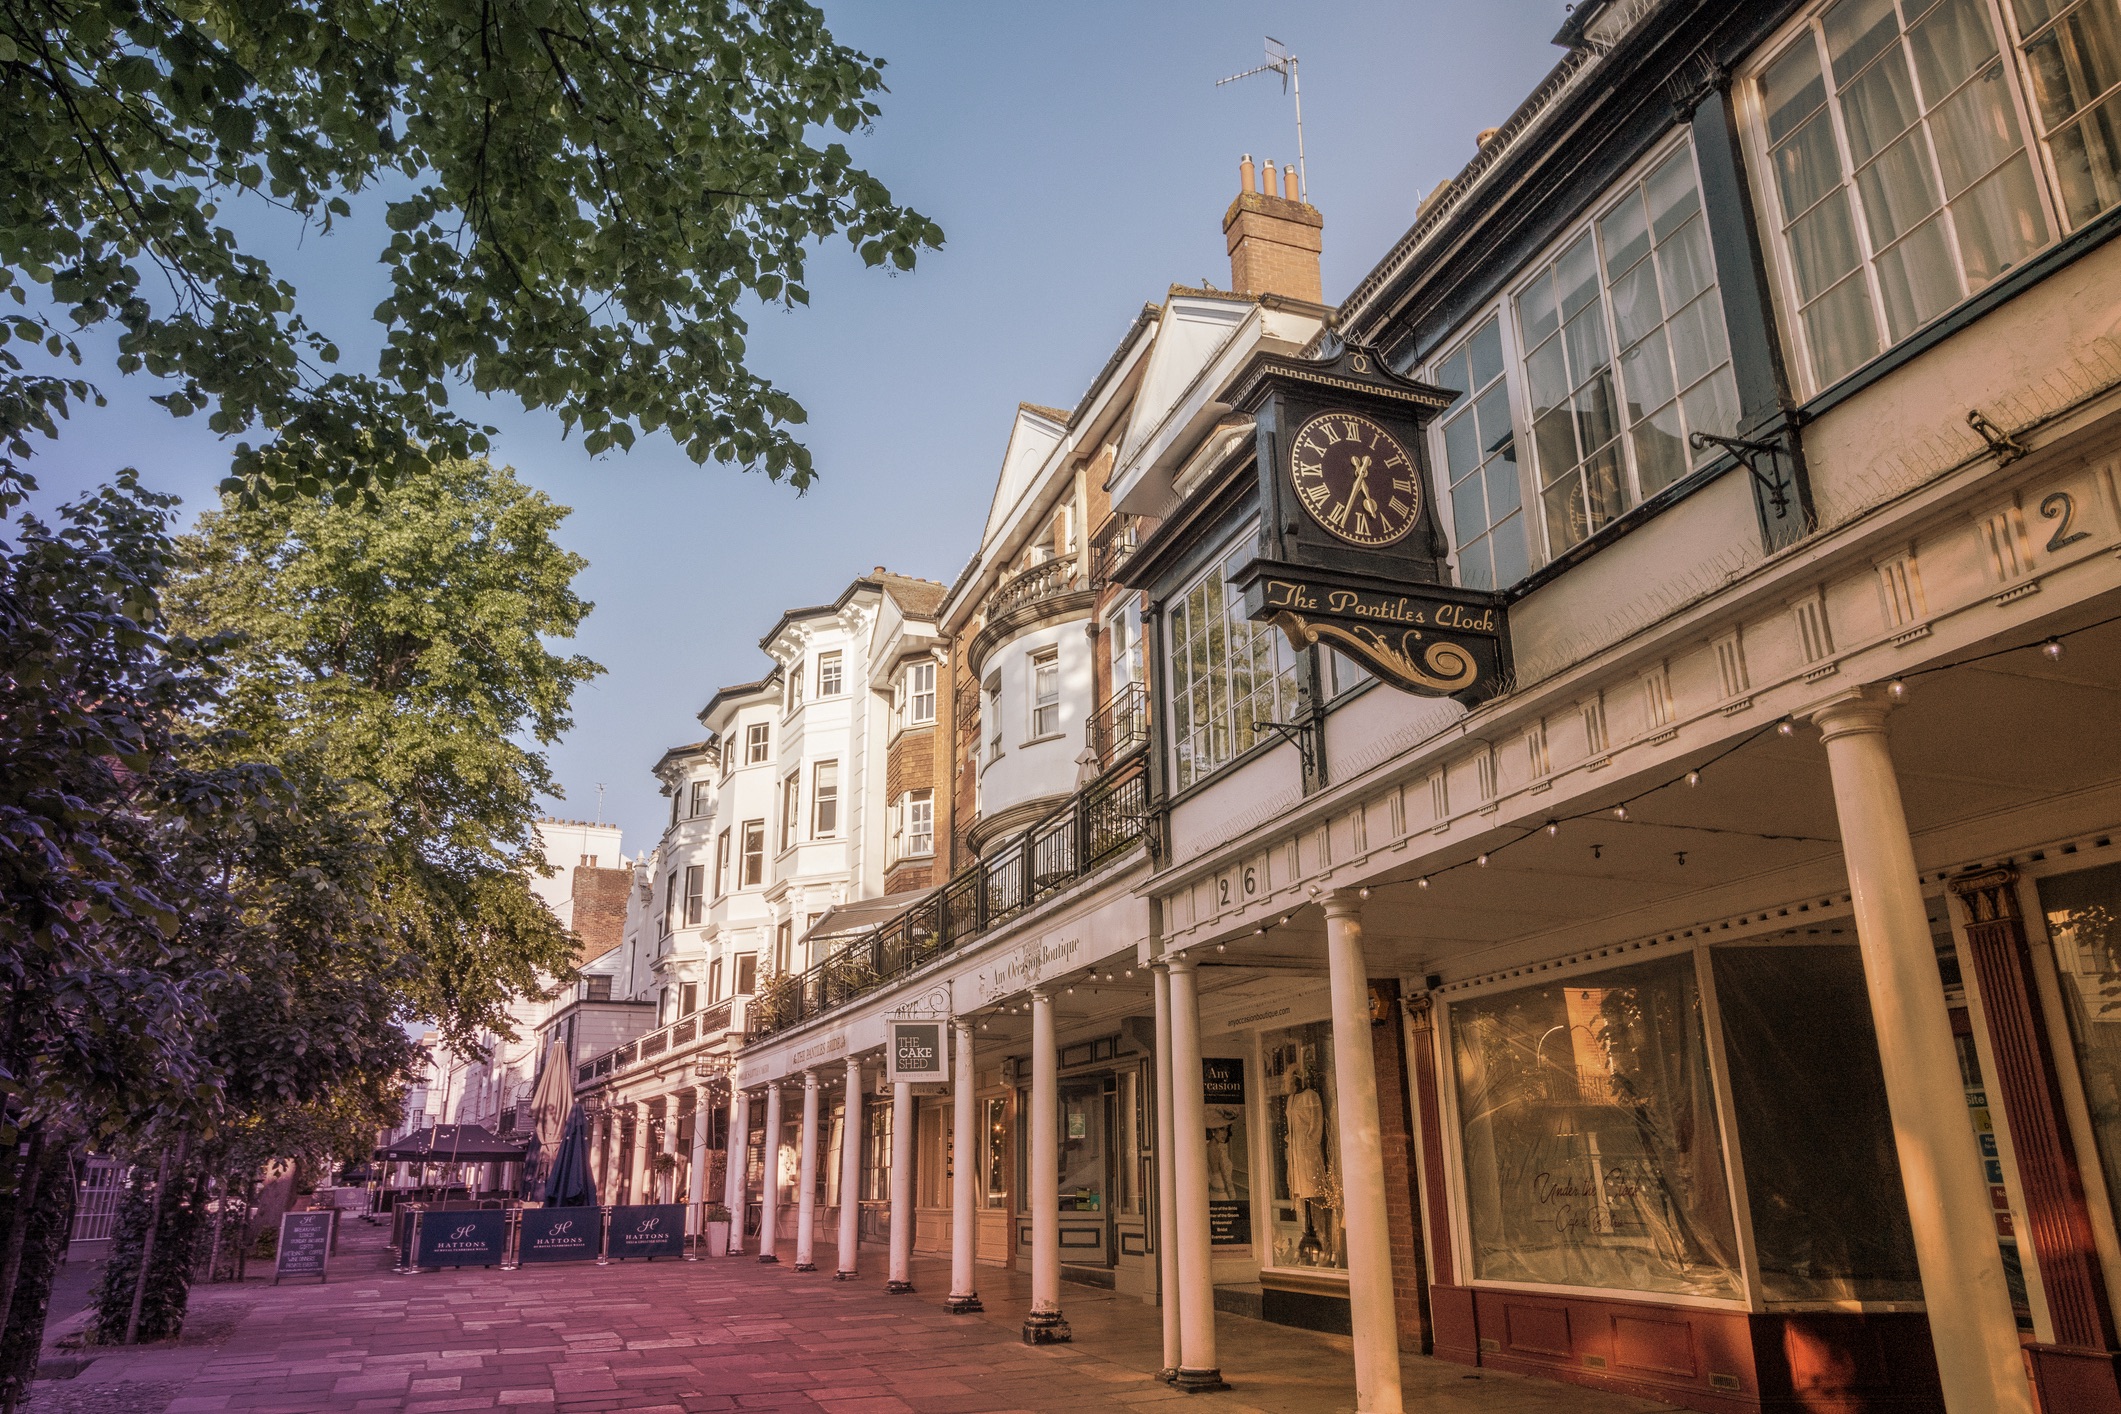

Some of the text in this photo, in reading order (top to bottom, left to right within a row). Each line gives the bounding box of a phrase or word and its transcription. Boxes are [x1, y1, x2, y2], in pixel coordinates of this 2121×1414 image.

[1319, 423, 1341, 445] XI
[1343, 421, 1361, 442] XII
[1304, 438, 1327, 458] X
[1300, 461, 1322, 477] IX
[1384, 455, 1402, 468] II
[1306, 482, 1331, 509] VIII
[1393, 478, 1411, 494] III
[1355, 512, 1371, 536] VI
[1380, 512, 1394, 534] V
[2040, 492, 2092, 552] 2
[1268, 581, 1494, 632] The Pantiles Clock
[1008, 956, 1042, 980] Occasion
[1043, 938, 1080, 965] Boutique
[1228, 1007, 1290, 1027] anyoccasionboutique.com
[898, 1037, 920, 1047] THE
[899, 1048, 932, 1057] CAKE
[899, 1059, 928, 1069] SHED
[1208, 1067, 1230, 1080] Any
[1534, 1168, 1641, 1205] Under the Clock
